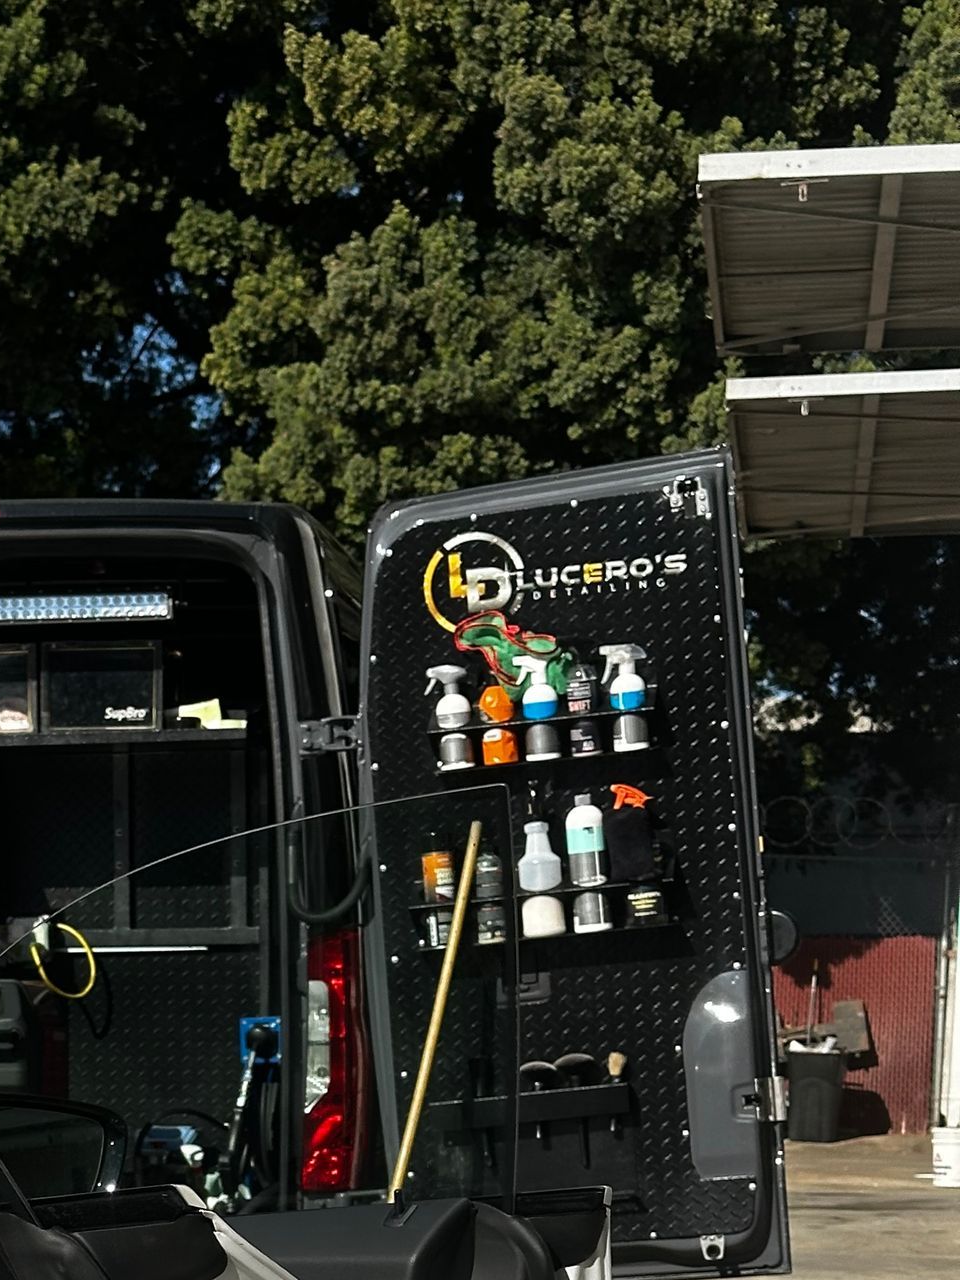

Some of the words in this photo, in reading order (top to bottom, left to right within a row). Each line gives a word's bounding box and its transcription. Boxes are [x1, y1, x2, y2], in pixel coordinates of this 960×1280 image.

[516, 554, 687, 590] LUCERO'S
[533, 578, 666, 600] DETAILING
[104, 706, 146, 721] SupBro
